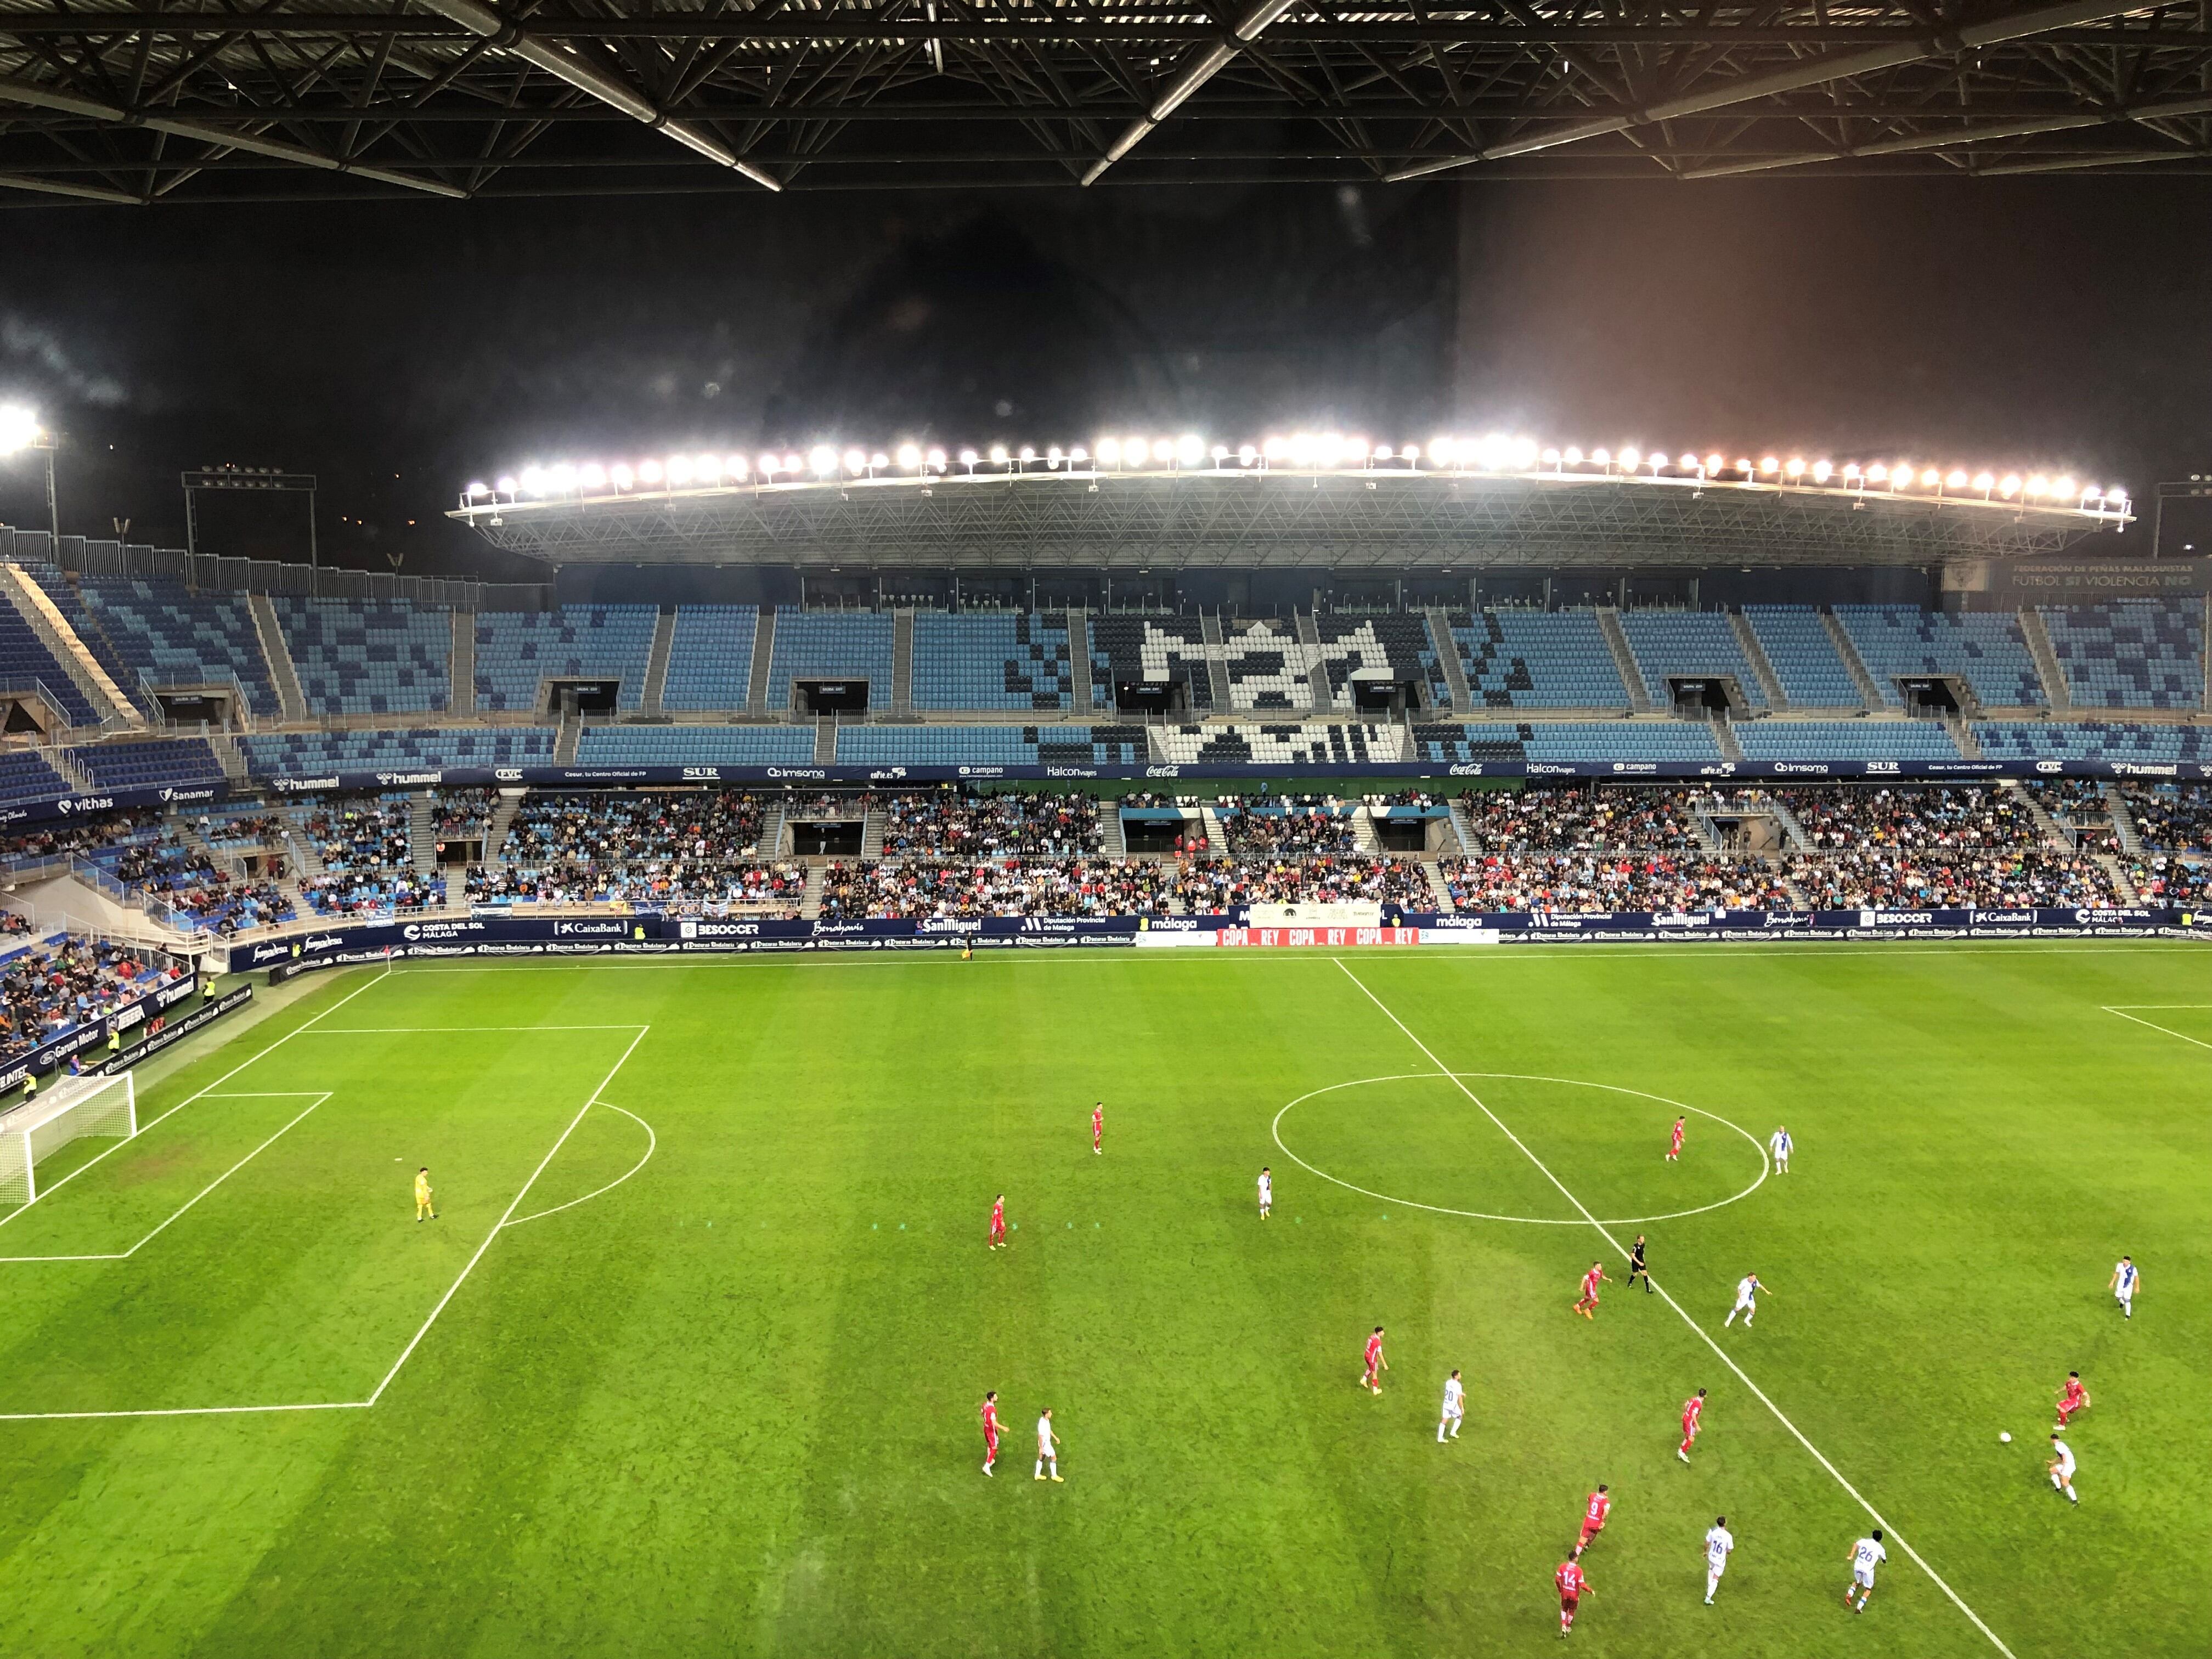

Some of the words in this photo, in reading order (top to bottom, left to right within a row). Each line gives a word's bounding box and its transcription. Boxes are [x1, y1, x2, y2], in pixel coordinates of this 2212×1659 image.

[2086, 576, 2160, 586] VIOLENCIA
[2164, 575, 2193, 586] NO
[683, 768, 719, 776] SUR
[1867, 761, 1899, 770] SUR
[2126, 763, 2177, 775] hummel
[290, 776, 339, 790] hummel
[393, 771, 442, 785] hummel
[172, 789, 214, 801] Sanamar
[75, 797, 113, 811] vithas
[1043, 916, 1073, 924] Diputación
[1877, 913, 1932, 923] BESOCCER
[1988, 912, 2031, 922] CaixaBank
[423, 930, 458, 939] MÁLAGA
[574, 923, 622, 933] CaixaBank
[698, 924, 759, 935] BESOCCER
[303, 934, 343, 952] famadesa
[1223, 930, 1248, 946] COPA
[1261, 929, 1279, 946] REY
[1289, 929, 1315, 946] COPA
[1328, 929, 1346, 945] REY
[1356, 928, 1382, 945] COPA
[1395, 928, 1413, 944] REY
[252, 943, 289, 962] famadesa
[167, 977, 194, 1003] hummel
[55, 1040, 77, 1058] Garum
[78, 1029, 99, 1046] Motor
[1591, 1502, 1598, 1515] 9
[1713, 1541, 1723, 1554] 16
[1859, 1547, 1872, 1562] 26
[1564, 1571, 1576, 1587] 14
